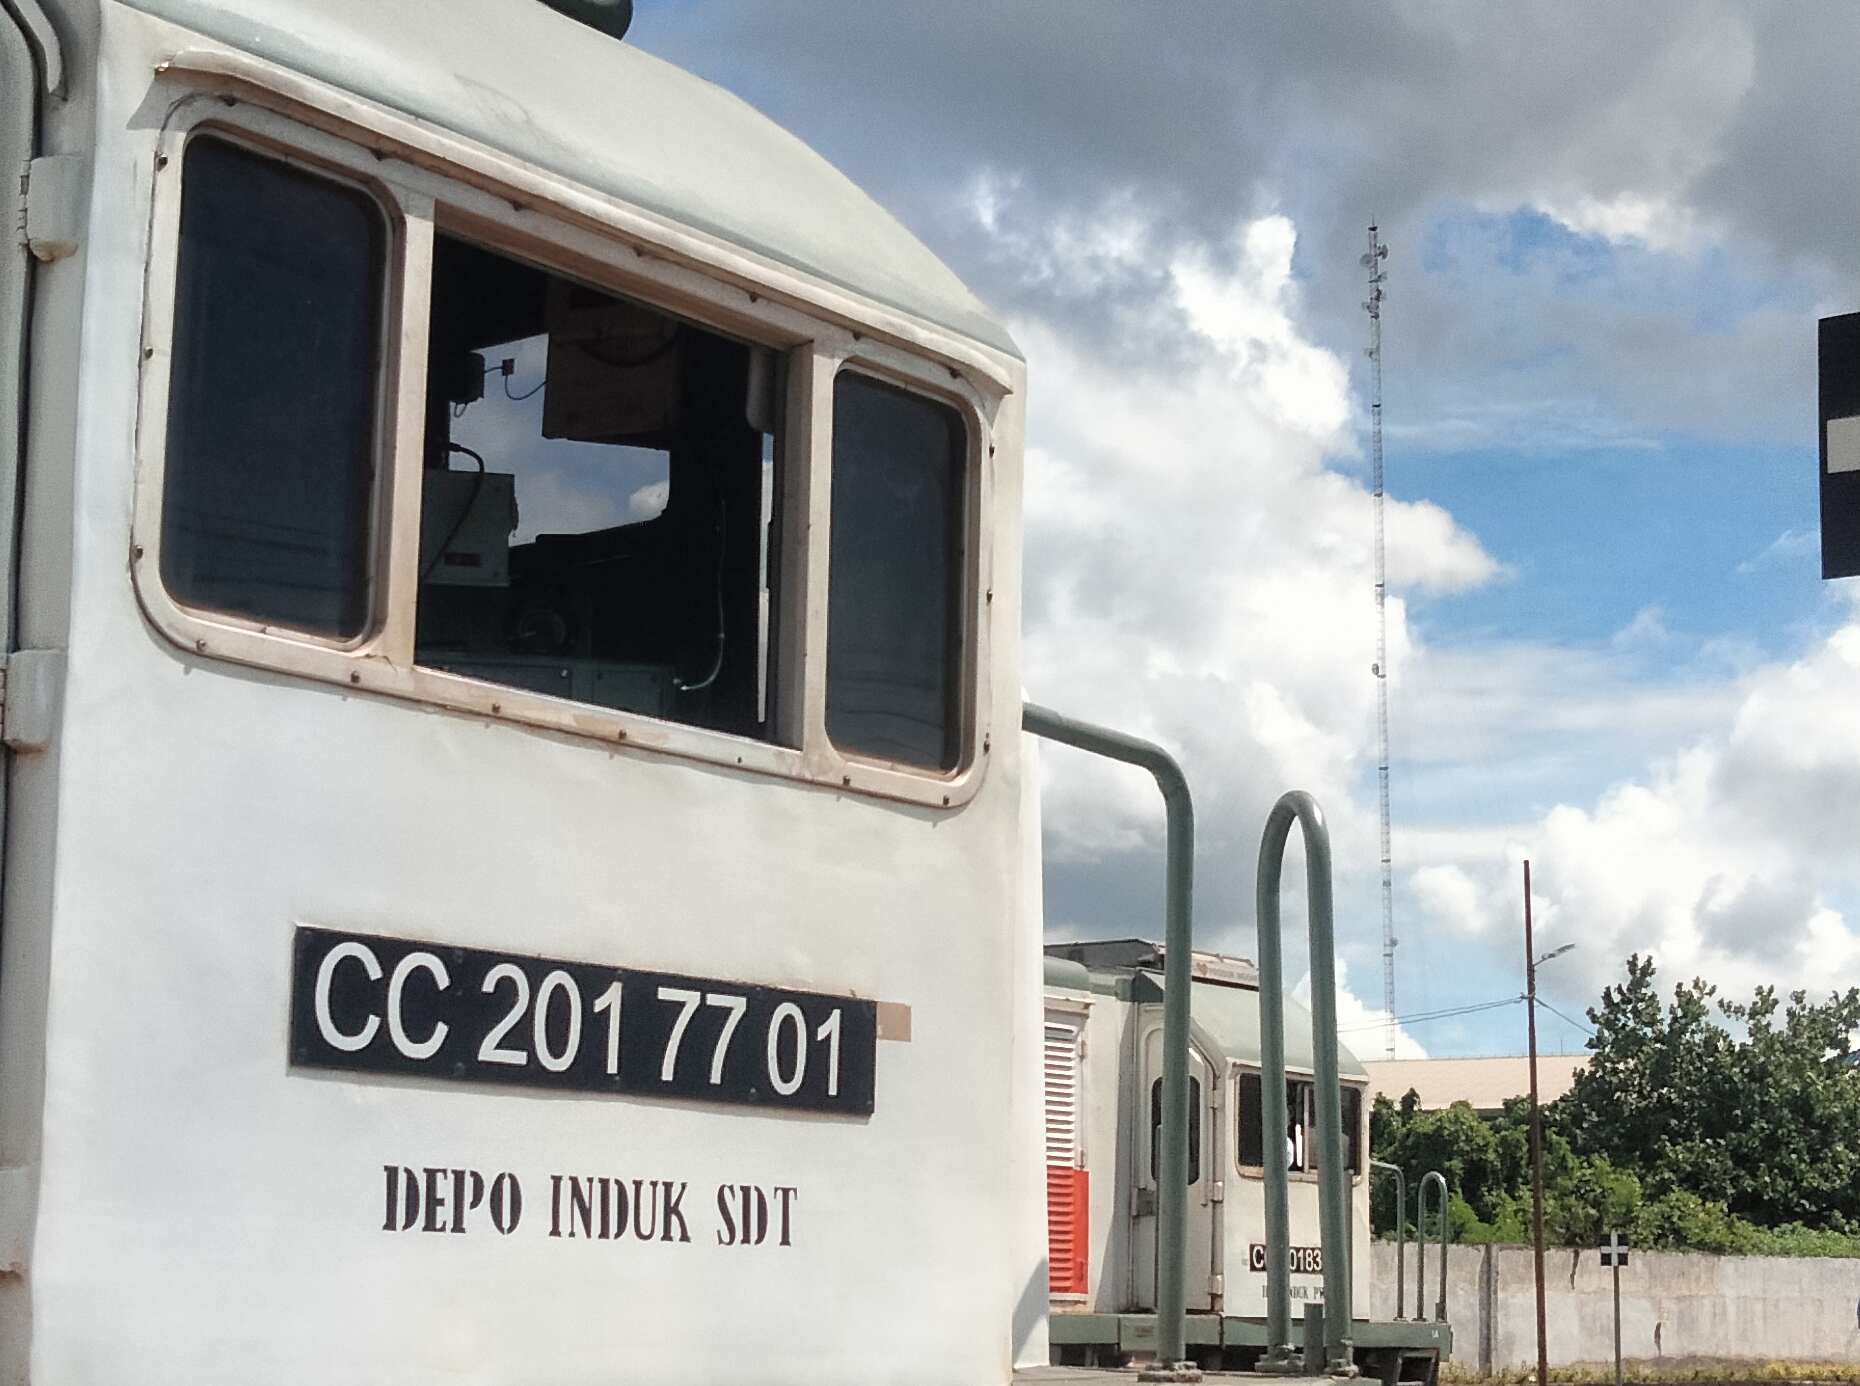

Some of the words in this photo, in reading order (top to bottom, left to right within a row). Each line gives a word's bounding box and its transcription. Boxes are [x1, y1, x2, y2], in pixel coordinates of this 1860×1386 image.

[314, 941, 450, 1060] CC
[477, 963, 623, 1075] 201
[657, 986, 748, 1085] 77
[767, 1001, 842, 1097] 01
[382, 1165, 523, 1236] DEPO
[548, 1174, 691, 1243] INDUK
[717, 1184, 799, 1247] SDT
